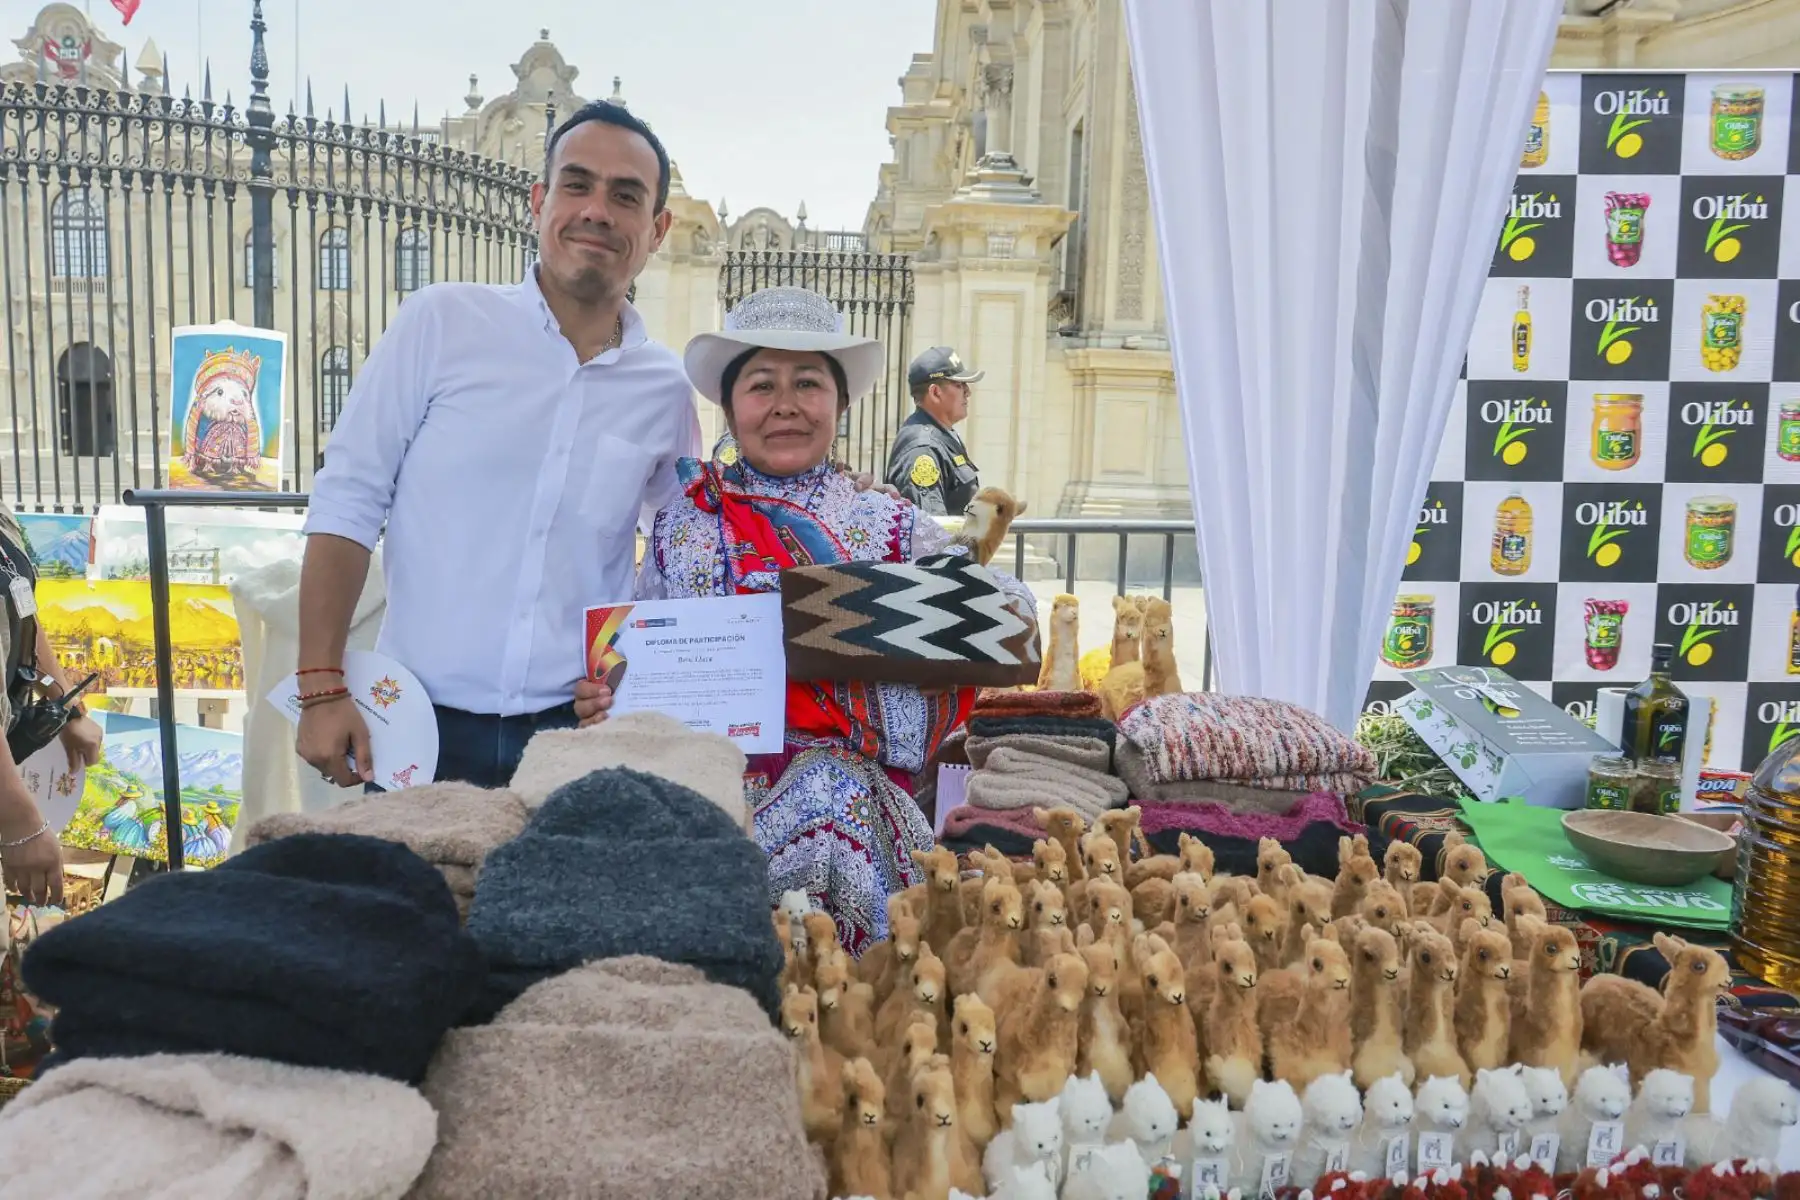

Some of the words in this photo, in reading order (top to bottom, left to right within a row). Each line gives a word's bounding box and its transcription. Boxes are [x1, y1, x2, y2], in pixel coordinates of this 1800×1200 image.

[1594, 89, 1670, 115] Olibú
[1506, 194, 1562, 219] libú
[1692, 194, 1768, 220] Olibú
[1585, 297, 1660, 324] Olibú
[1480, 399, 1554, 425] Olibú
[1681, 400, 1755, 426] Olibú
[1575, 501, 1648, 527] Olibú
[1472, 600, 1543, 626] Olibú
[1667, 601, 1739, 627] Olibú
[645, 638, 677, 646] DIPLOMA
[679, 637, 689, 645] DE
[689, 634, 746, 644] PARTICIPACIÓN
